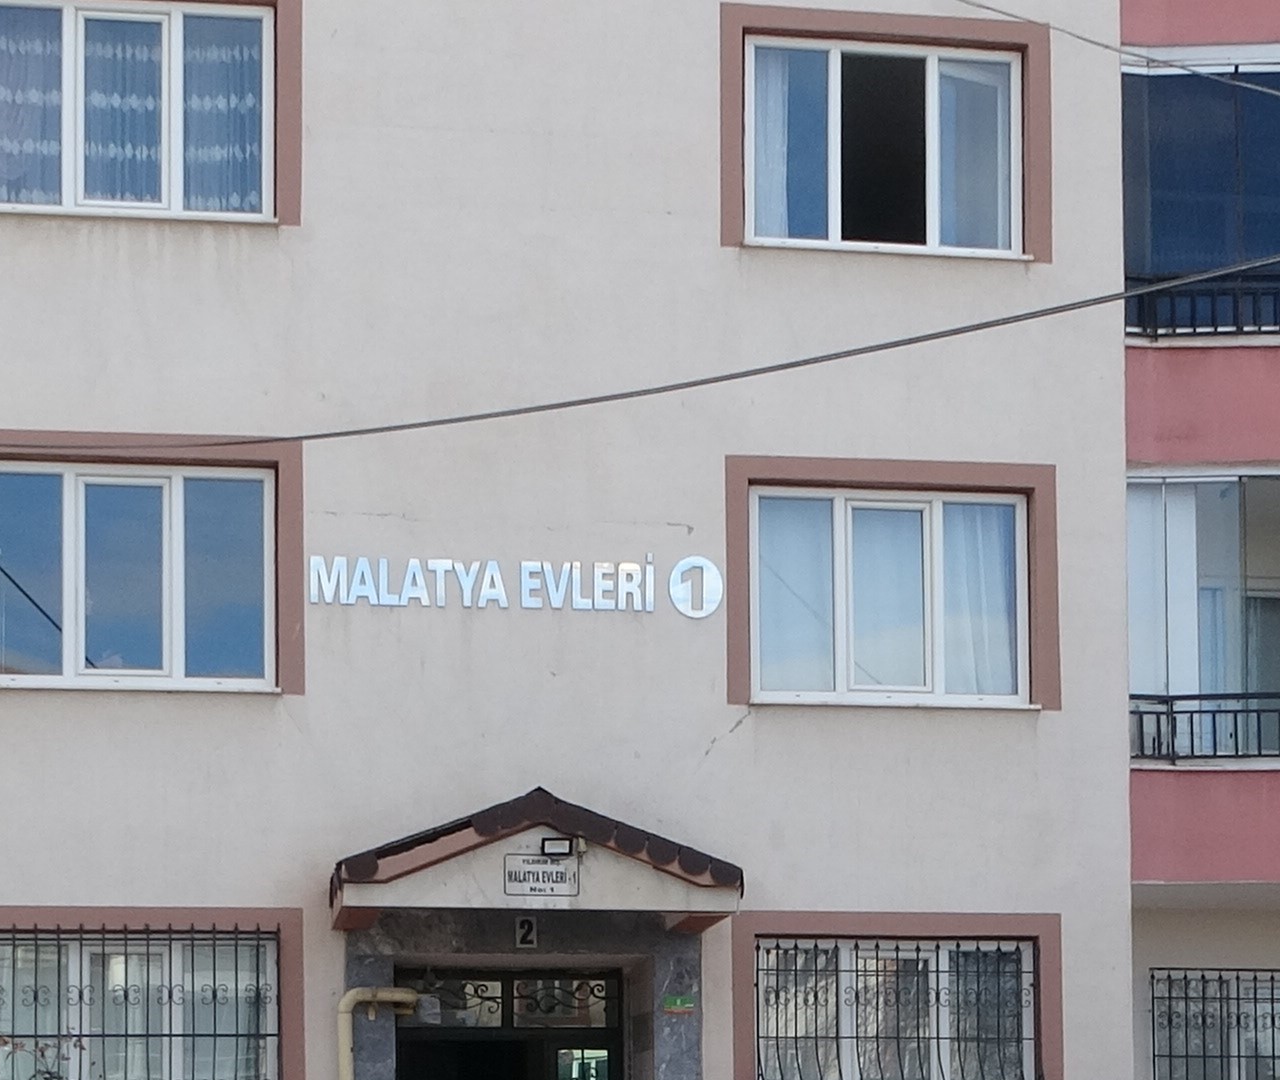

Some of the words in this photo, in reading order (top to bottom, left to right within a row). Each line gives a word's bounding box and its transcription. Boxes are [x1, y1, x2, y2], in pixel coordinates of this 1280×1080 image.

[308, 556, 509, 608] MALATYA
[521, 553, 656, 613] EVLERİ
[507, 870, 540, 884] MALATYA
[519, 918, 534, 945] 2
